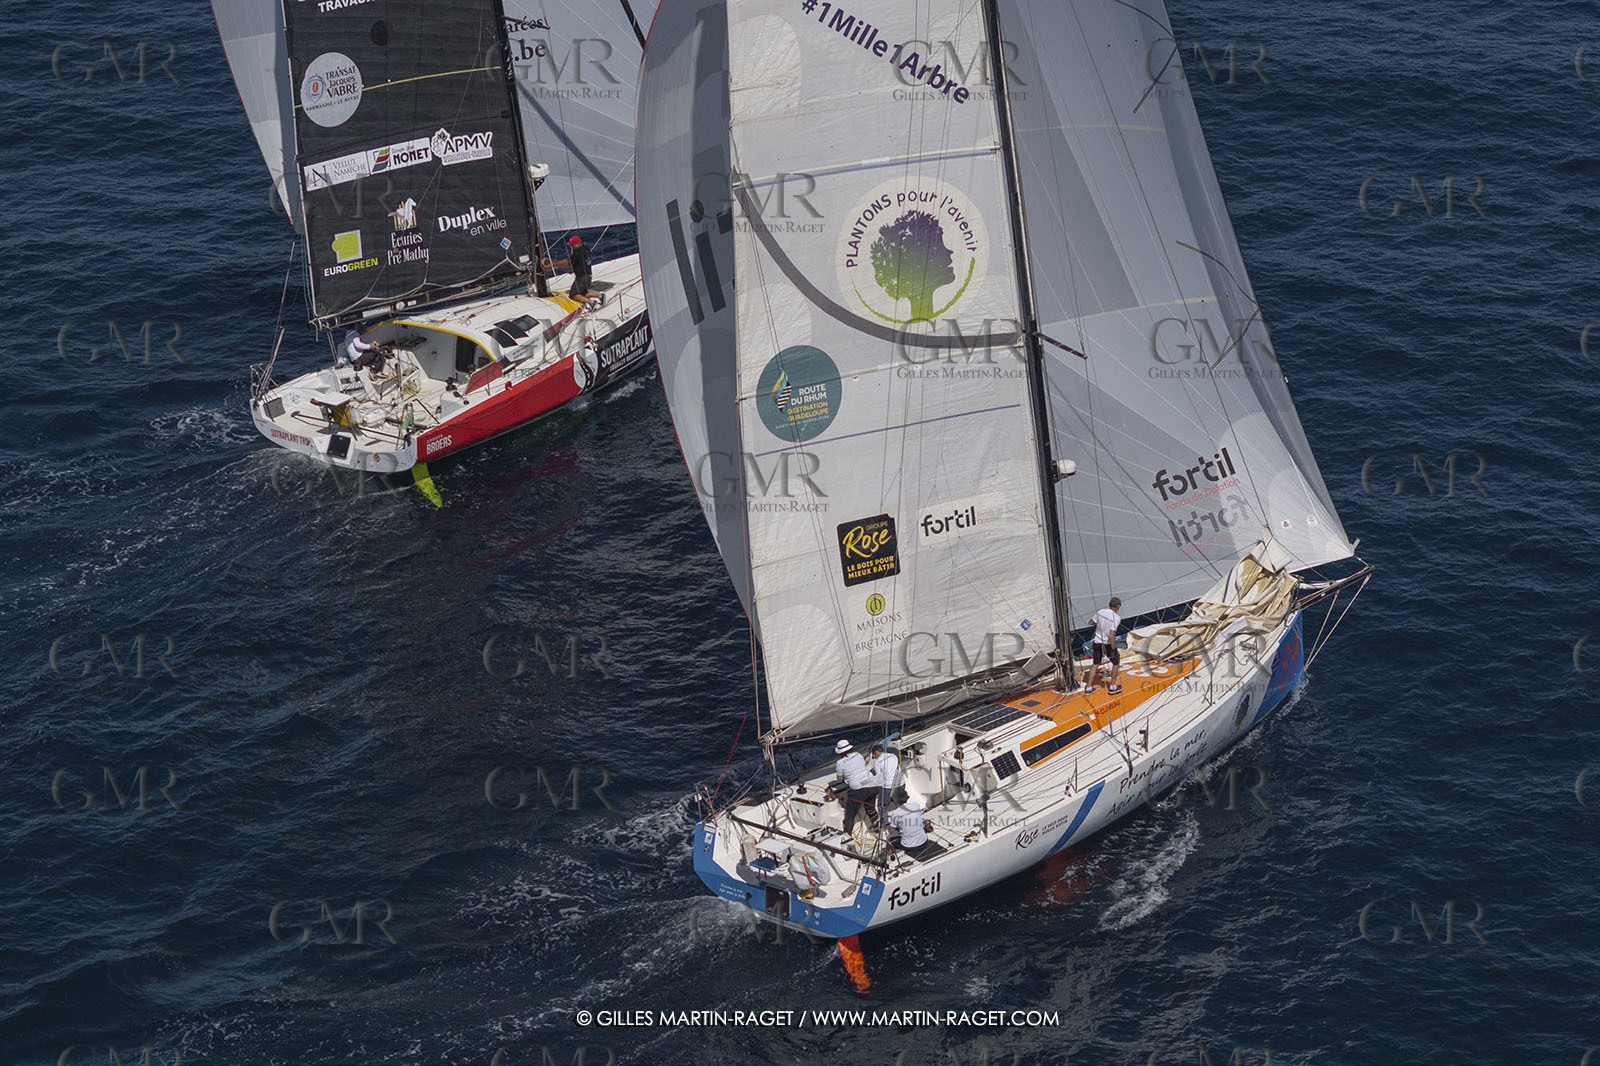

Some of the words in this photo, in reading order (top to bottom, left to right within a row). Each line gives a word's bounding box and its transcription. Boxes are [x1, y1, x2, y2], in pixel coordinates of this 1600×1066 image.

[317, 0, 377, 13] TRAVA
[509, 38, 546, 62] .be
[801, 0, 968, 104] #1Mille1Arbre
[325, 66, 356, 80] TRANSAT
[329, 75, 356, 88] Jacques
[327, 82, 358, 98] VABRE
[443, 133, 491, 155] APMV
[392, 147, 430, 165] NONET
[437, 205, 496, 233] Duplex
[469, 224, 485, 237] en
[486, 217, 507, 233] ville
[846, 193, 892, 268] PLANTONS
[896, 190, 938, 207] pour
[939, 195, 978, 252] l'avenir
[391, 231, 424, 249] Ecuries
[402, 246, 430, 264] Mathy
[323, 257, 379, 277] EUROGREEN
[600, 324, 648, 368] SOTRAPLANT
[790, 397, 803, 406] DU
[804, 391, 828, 403] RHUM
[798, 383, 826, 396] ROUTE
[426, 434, 453, 455] BROERS
[1152, 447, 1237, 502] fortil
[920, 506, 976, 537] fortil
[842, 525, 893, 559] Rose
[847, 564, 856, 572] LE
[856, 560, 874, 569] BOIS
[874, 555, 894, 565] POUR
[848, 568, 872, 579] MIEUX
[856, 611, 902, 632] MAISONS
[855, 630, 908, 652] BRETAGNE
[1119, 759, 1166, 794] Prendre
[1014, 828, 1039, 851] Rose
[887, 871, 942, 911] fortil
